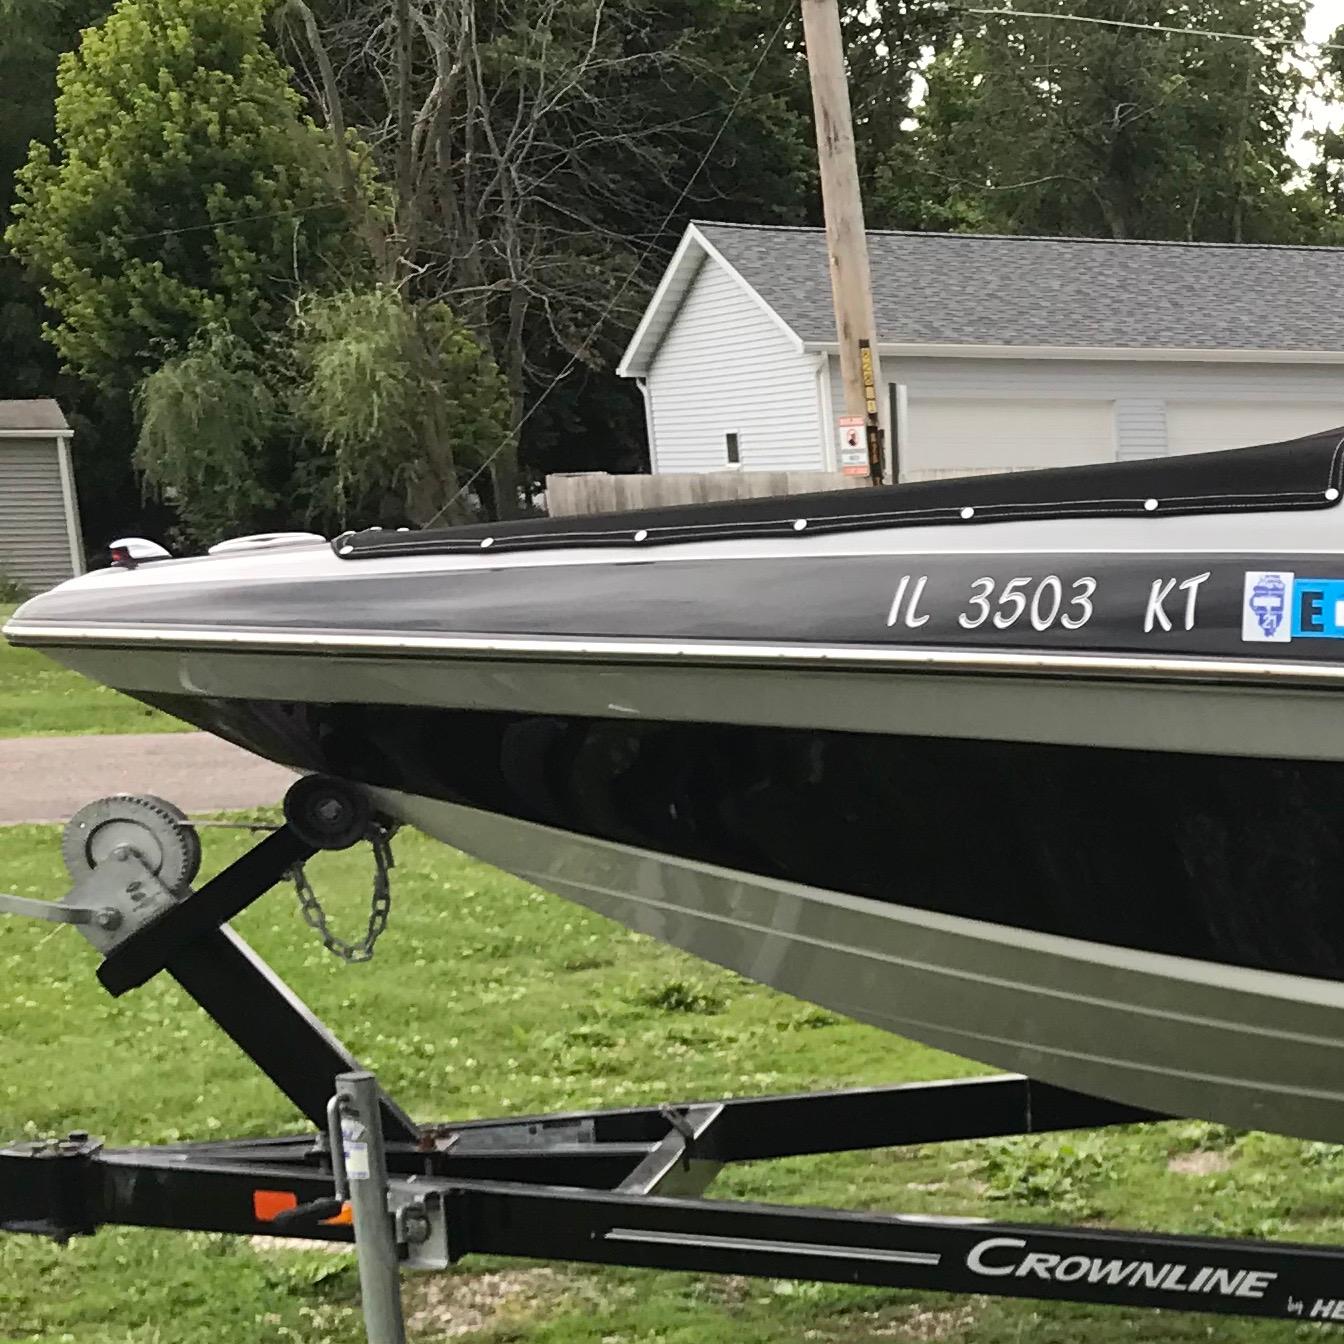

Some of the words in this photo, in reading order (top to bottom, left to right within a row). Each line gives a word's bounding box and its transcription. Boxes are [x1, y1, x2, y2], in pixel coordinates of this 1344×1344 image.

[886, 575, 930, 628] IL
[958, 575, 1097, 632] 3503
[1143, 571, 1211, 633] KT
[1301, 591, 1324, 632] E
